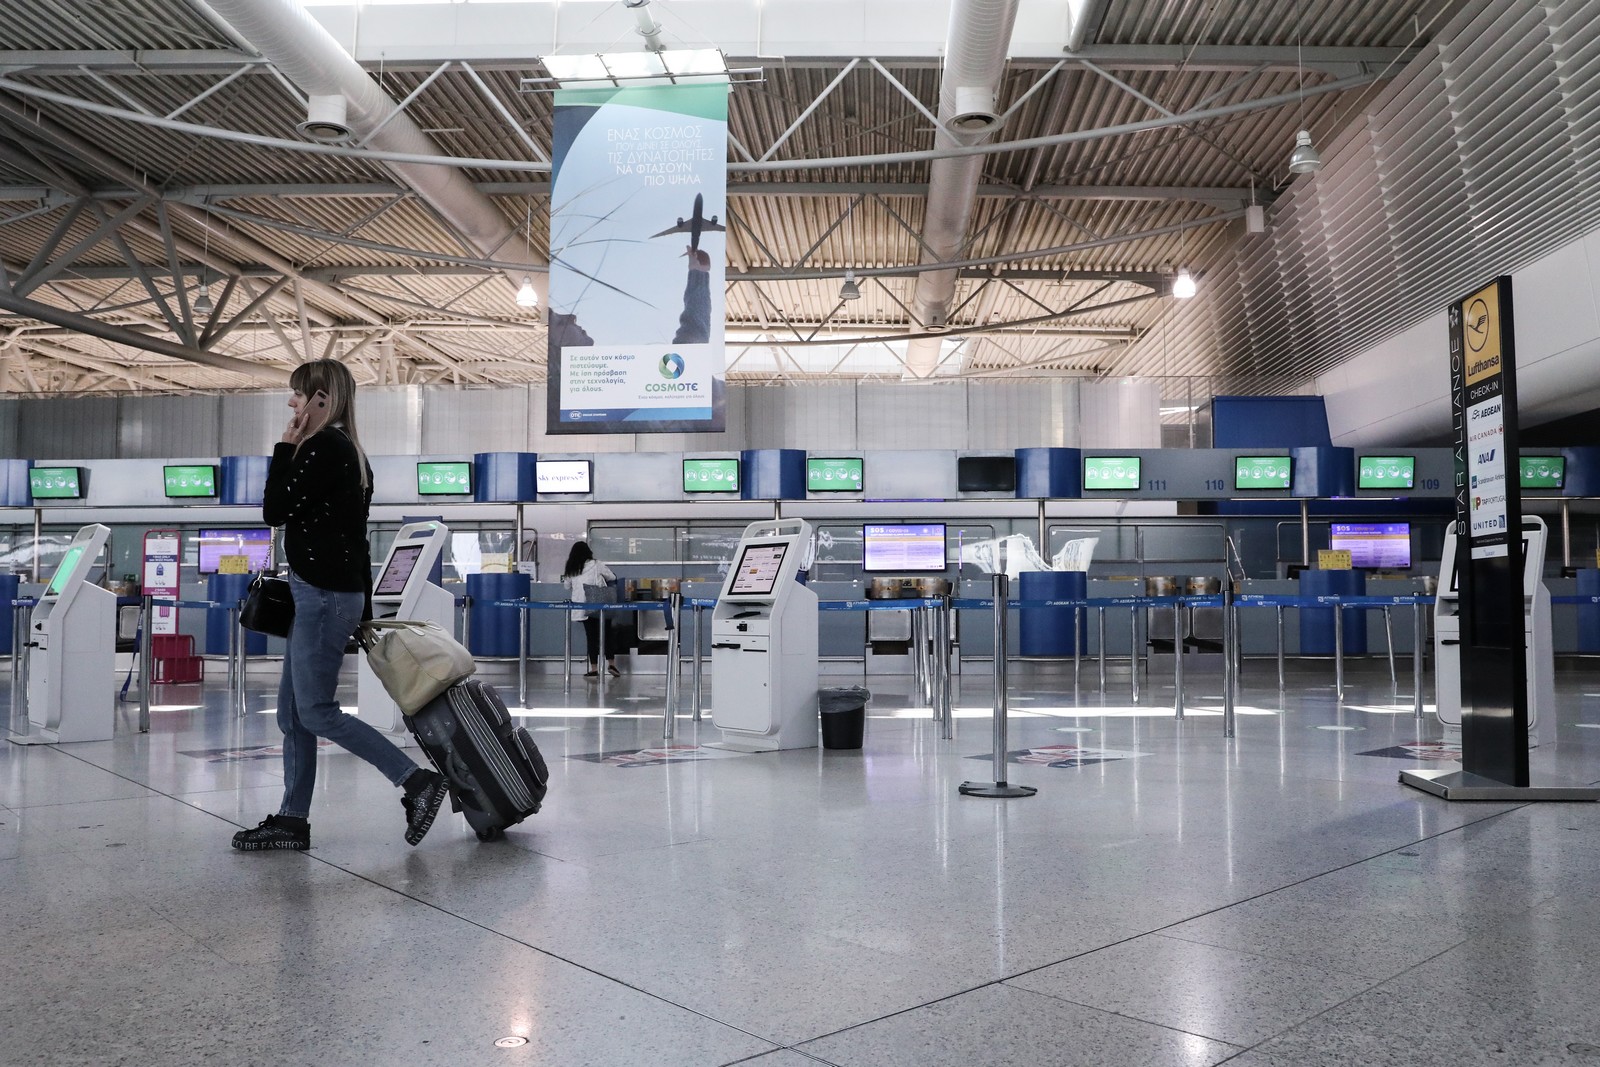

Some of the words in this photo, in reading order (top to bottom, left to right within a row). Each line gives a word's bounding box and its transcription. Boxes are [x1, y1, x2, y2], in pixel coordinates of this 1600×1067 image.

[608, 128, 640, 142] ΕΝΑΣ
[644, 126, 702, 140] ΚΟΣΜΟΣ
[608, 152, 624, 164] ΤΙΣ
[628, 148, 714, 163] ΔΥΝΑΤΟΤΗΤΕΣ
[616, 164, 632, 174] ΝΑ
[637, 162, 692, 174] ΦΤΑΣΟΥΝ
[644, 175, 665, 187] ΠΙΟ
[669, 174, 701, 185] ΨΗΛΑ
[1468, 354, 1500, 377] Lufthansa
[1470, 380, 1499, 400] CHECK-IN
[1452, 337, 1464, 462] ALLIANCE
[1480, 404, 1501, 419] AEGEAN
[1478, 428, 1497, 441] CANADA
[1478, 452, 1490, 465] ANA
[1148, 480, 1167, 491] 111
[1205, 480, 1224, 490] 110
[1420, 478, 1440, 490] 109
[1456, 470, 1466, 536] STAR
[1473, 519, 1498, 530] UNITED
[421, 818, 432, 832] BE
